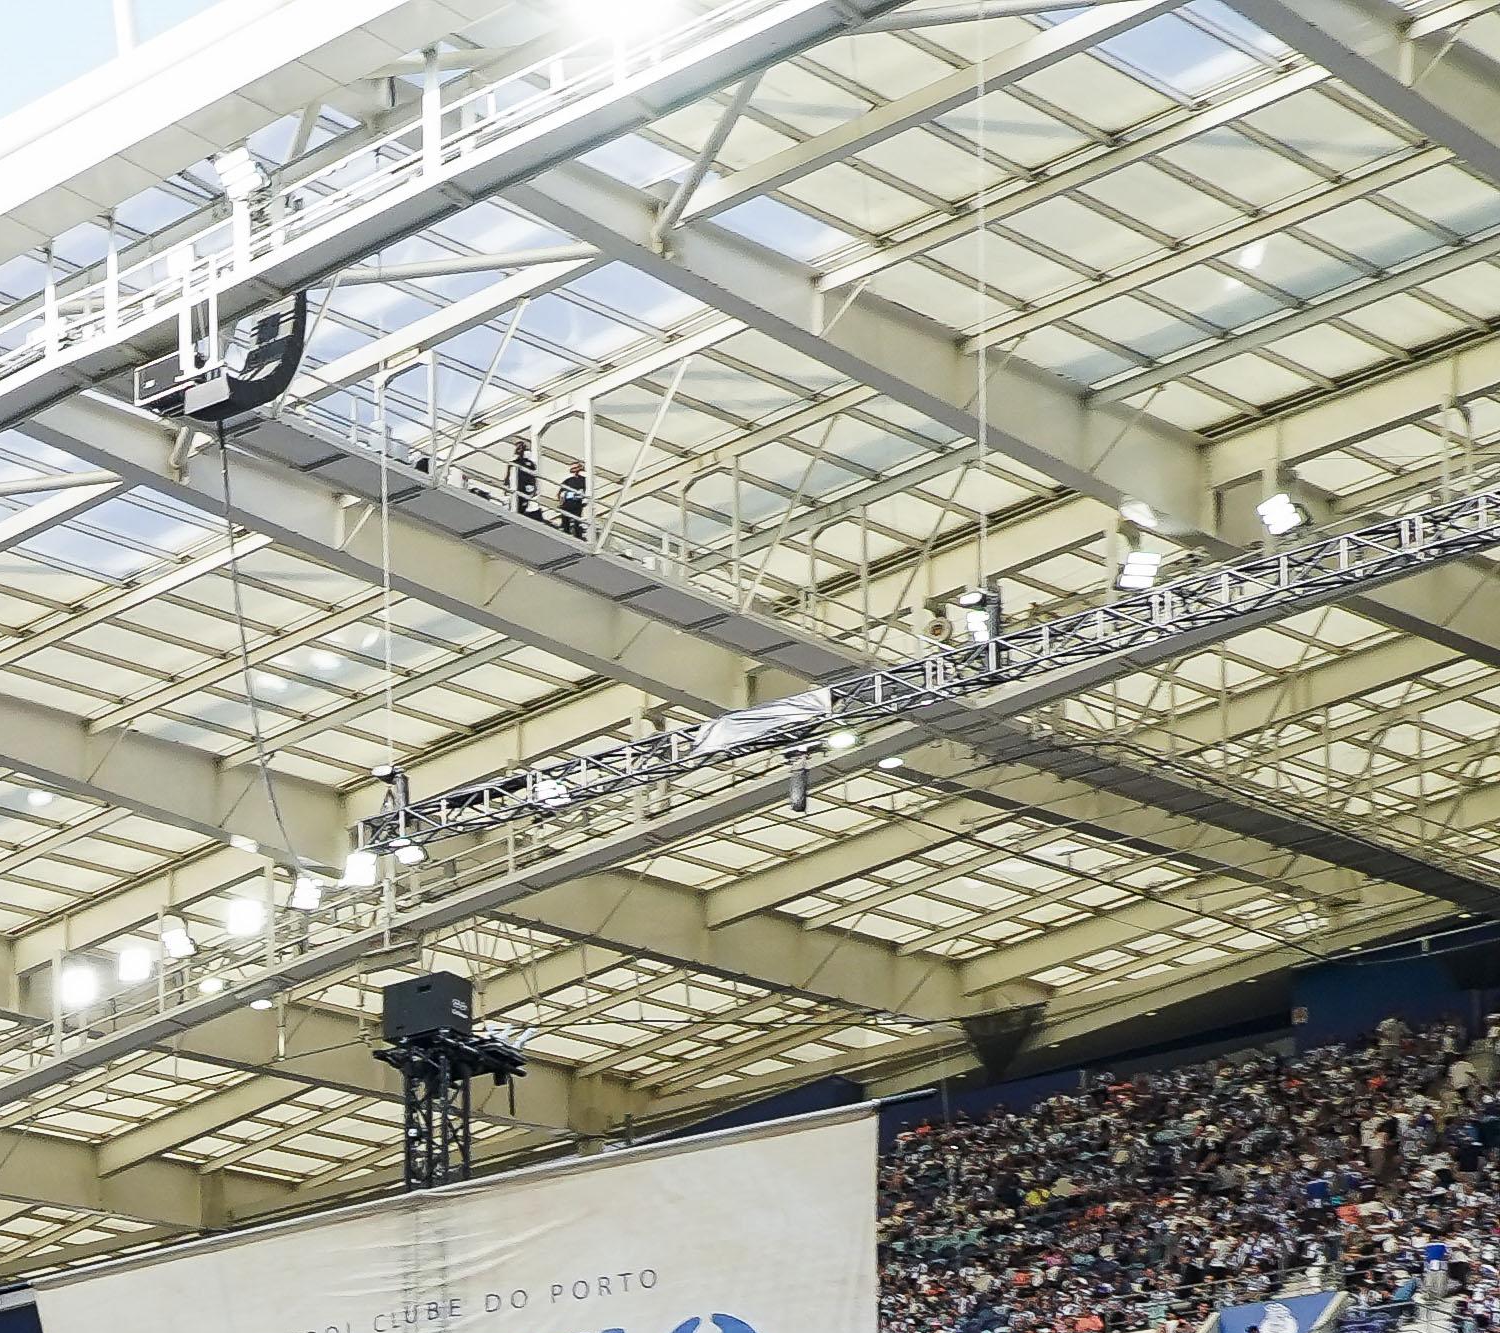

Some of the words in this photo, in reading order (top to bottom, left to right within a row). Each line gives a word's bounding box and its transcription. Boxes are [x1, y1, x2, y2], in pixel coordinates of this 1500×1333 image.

[373, 1298, 462, 1333] CLUBE
[485, 1289, 530, 1313] DO
[550, 1269, 658, 1303] PORTO
